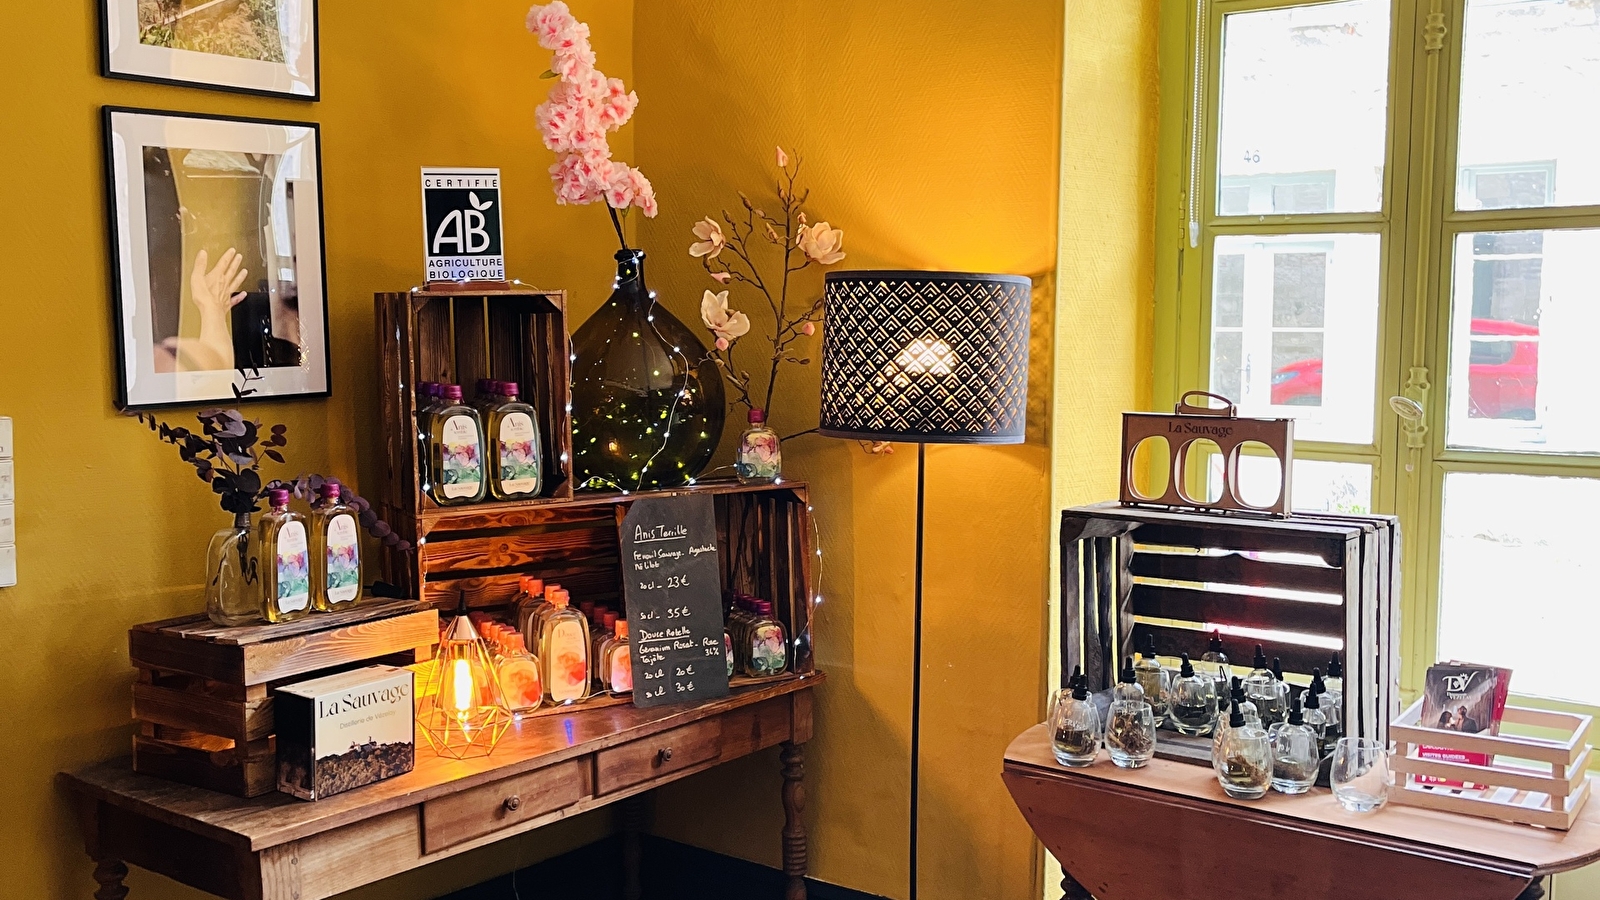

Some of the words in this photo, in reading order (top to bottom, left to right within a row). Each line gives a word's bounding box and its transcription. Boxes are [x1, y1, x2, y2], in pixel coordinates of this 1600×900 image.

[1244, 150, 1260, 163] 46
[425, 179, 498, 188] CERTIFIE
[432, 209, 490, 253] AB
[428, 258, 503, 268] AGRICULTURE
[429, 269, 504, 279] BIOLOGIQUE
[1168, 421, 1182, 433] La
[1184, 422, 1233, 438] Sauvage
[635, 524, 656, 540] Anis
[639, 629, 664, 640] Douce
[319, 700, 339, 719] La
[342, 684, 409, 713] Sauvage
